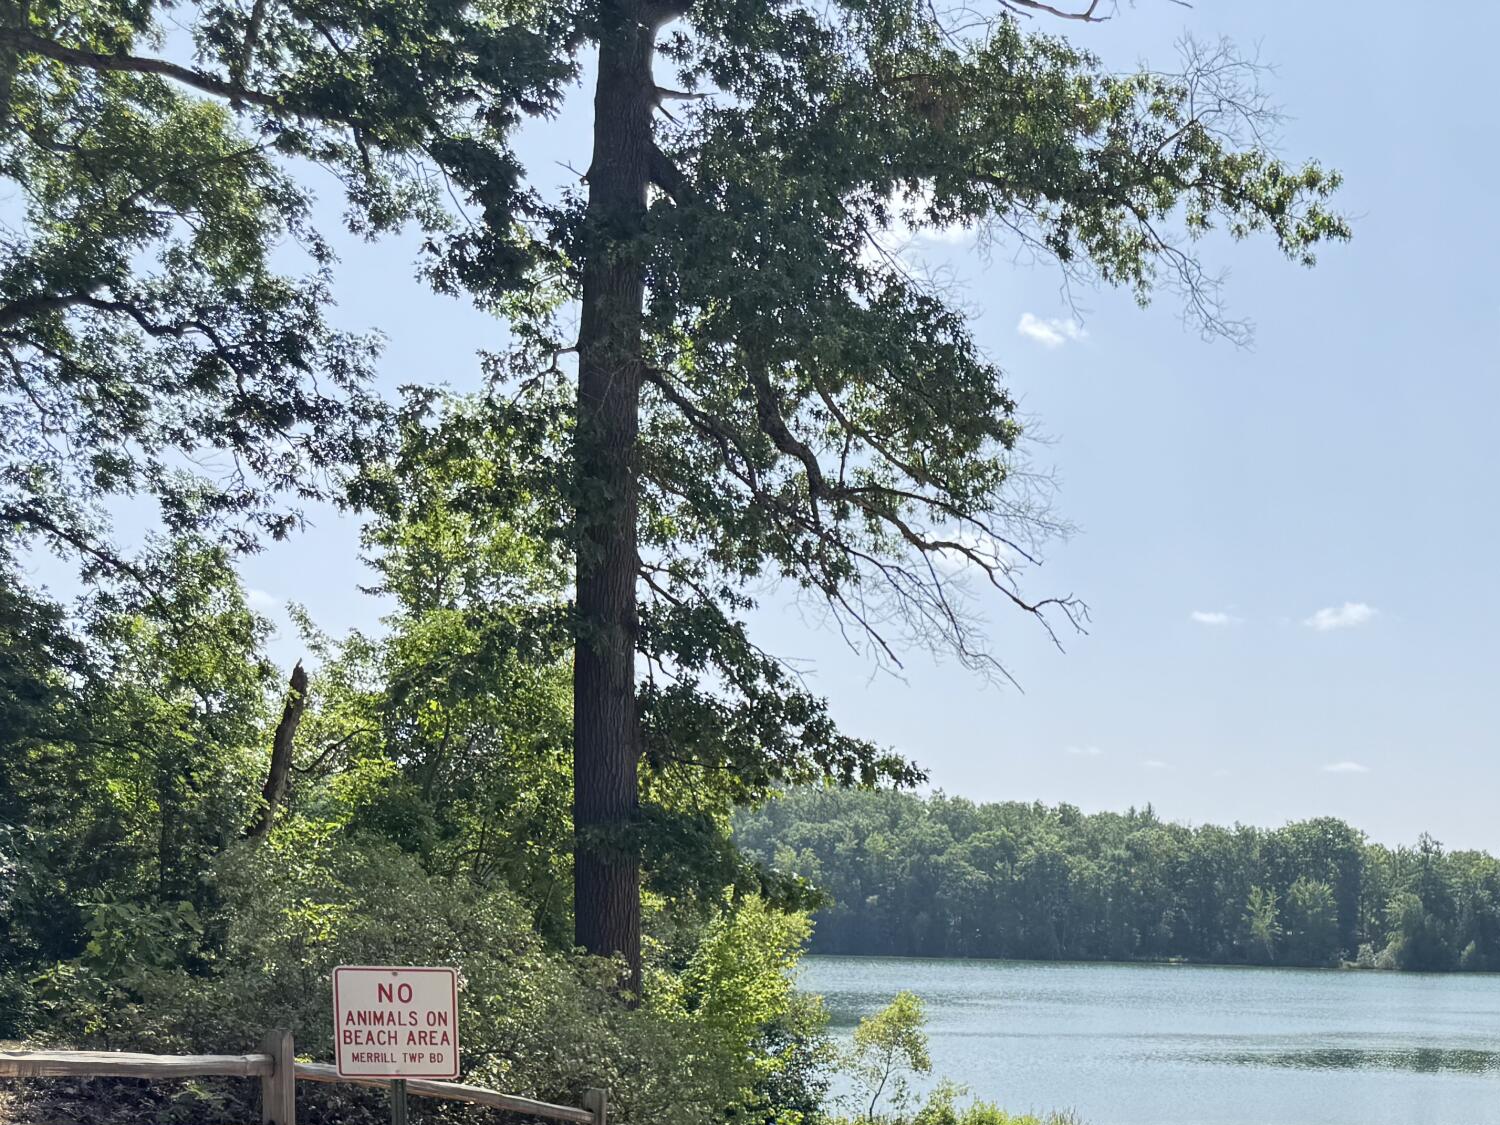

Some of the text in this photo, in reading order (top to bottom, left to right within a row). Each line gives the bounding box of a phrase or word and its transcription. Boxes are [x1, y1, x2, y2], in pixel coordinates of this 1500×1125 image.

[377, 982, 413, 1003] NO
[345, 1010, 448, 1026] ANIMALS ON
[343, 1029, 450, 1046] BEACH AREA
[351, 1052, 444, 1063] MERRILL TWP BD
